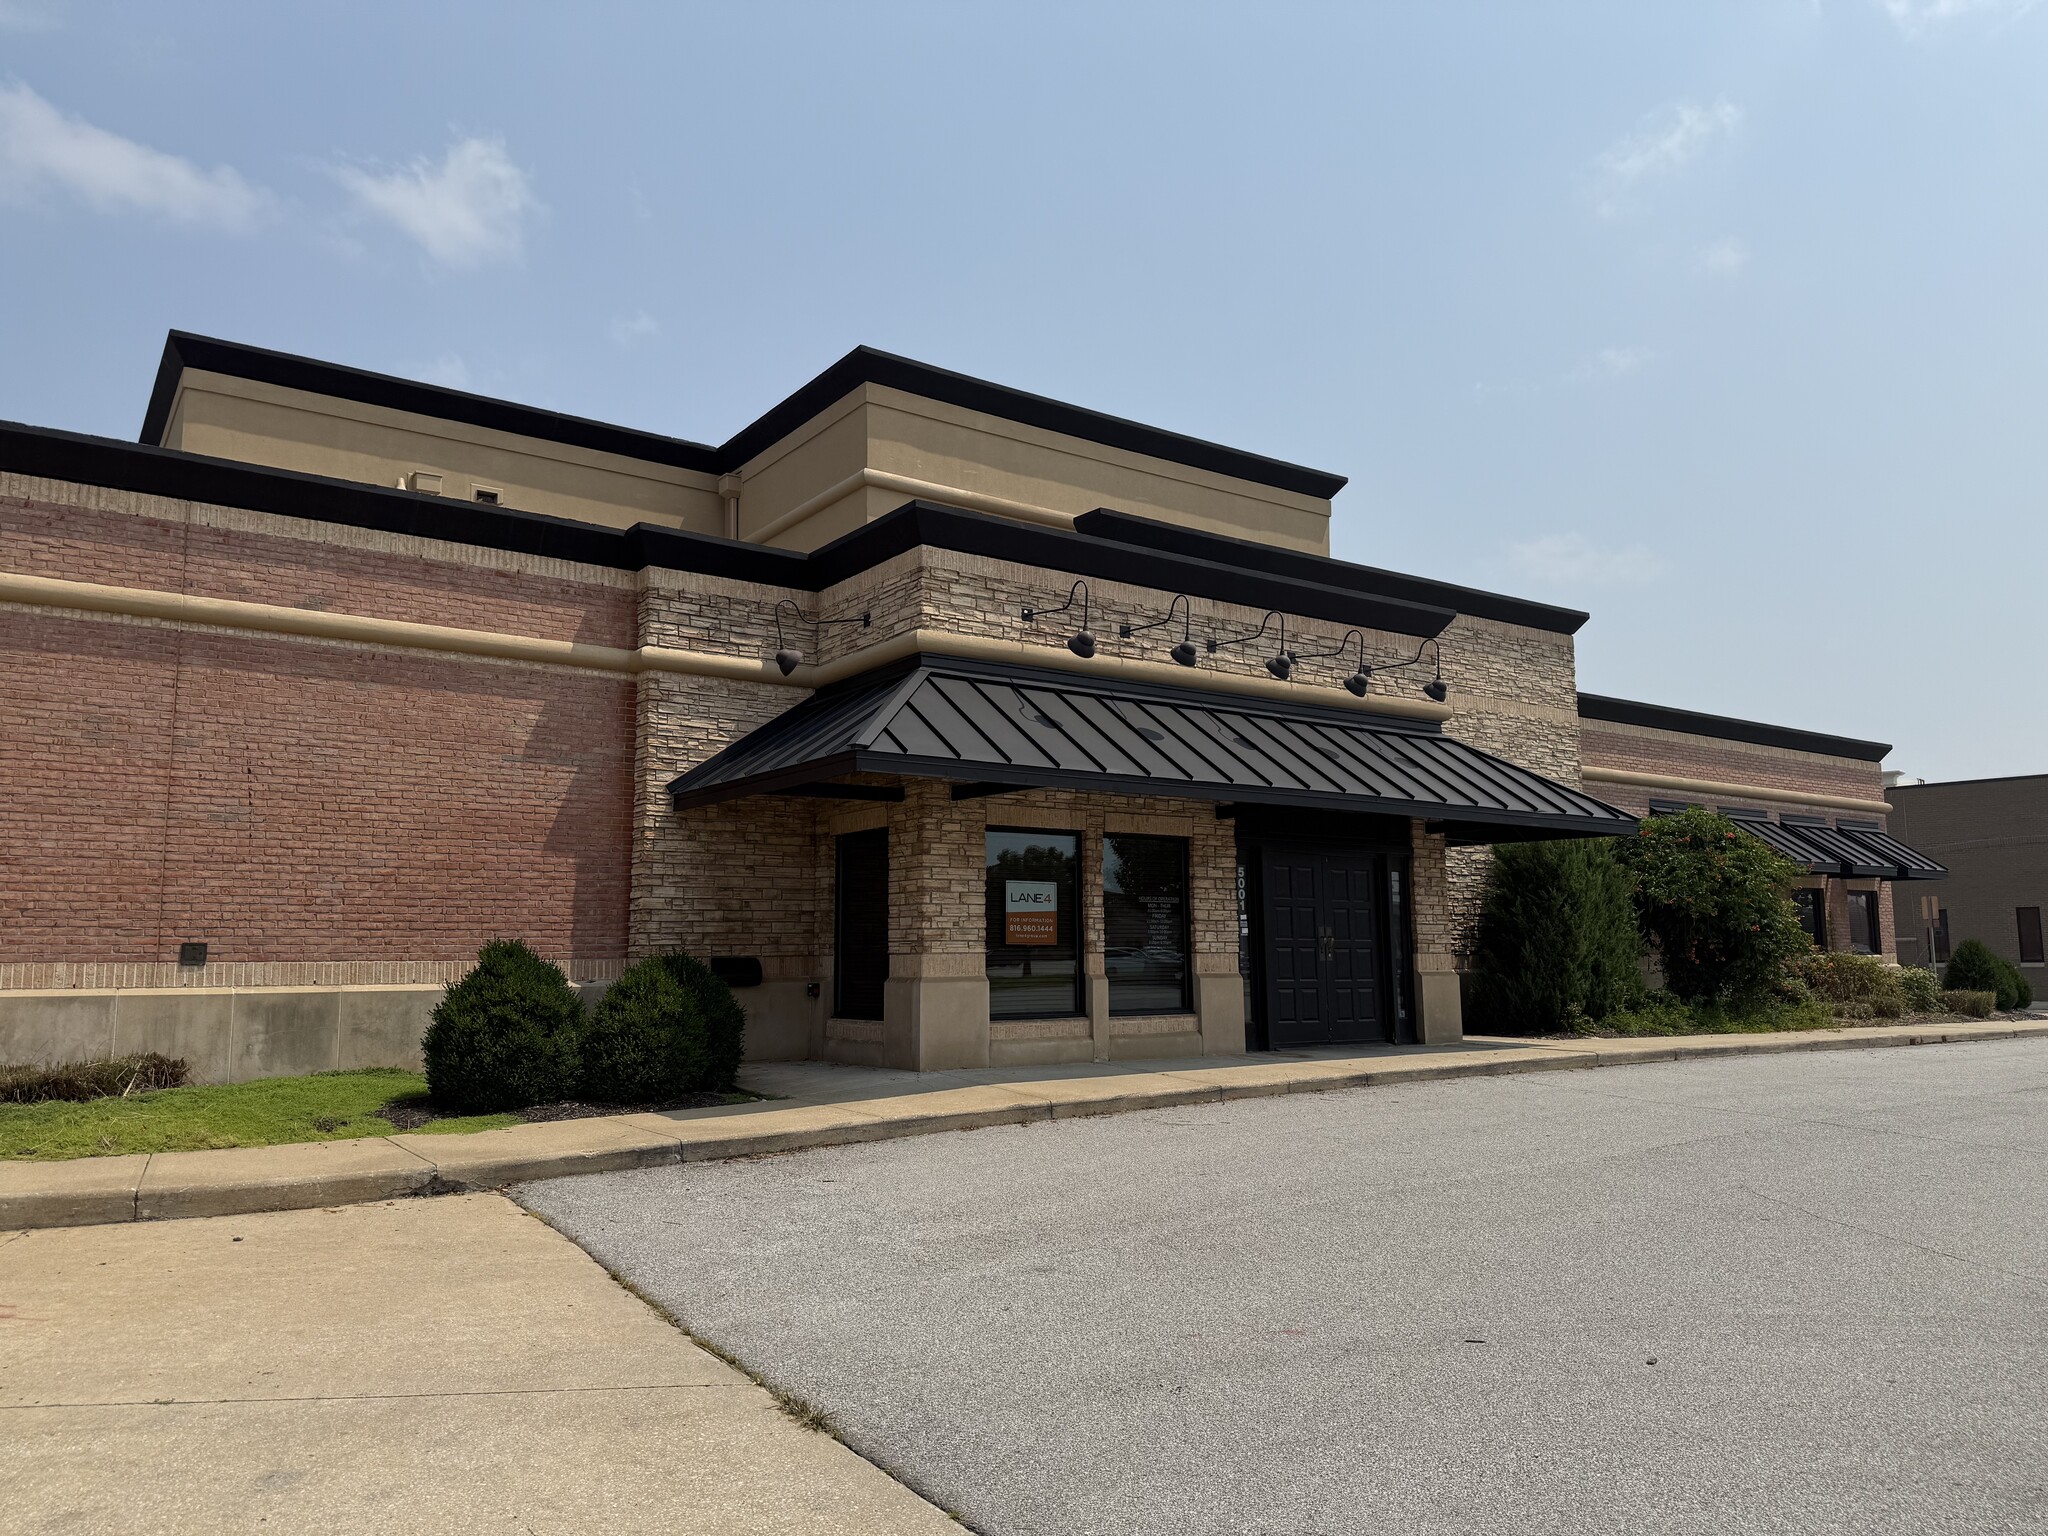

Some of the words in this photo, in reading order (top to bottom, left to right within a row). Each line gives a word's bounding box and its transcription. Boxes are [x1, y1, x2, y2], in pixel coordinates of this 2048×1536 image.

[1238, 866, 1246, 911] 5001
[1010, 892, 1052, 904] LANE4
[1009, 924, 1054, 932] 816.960.1444
